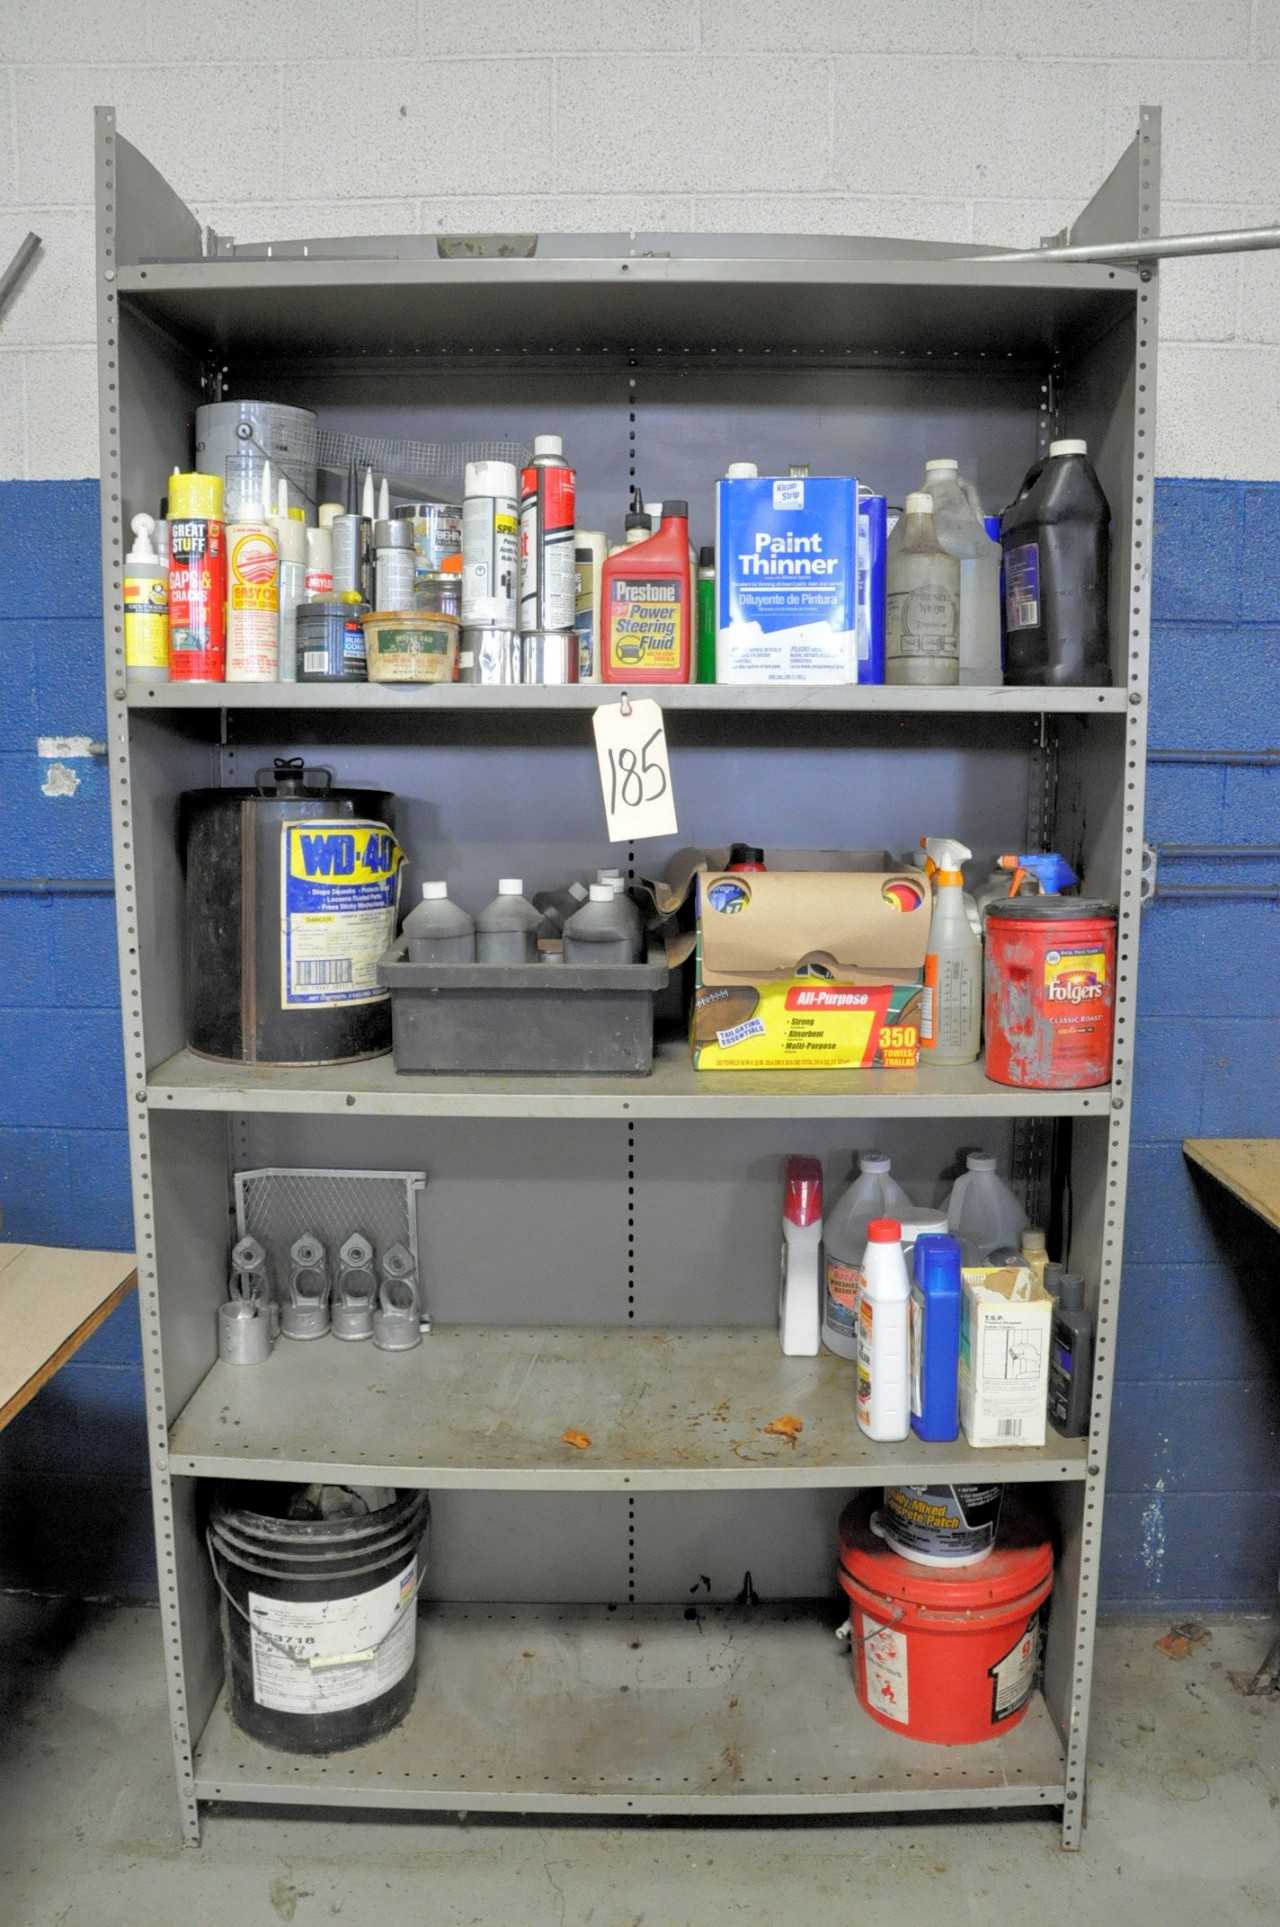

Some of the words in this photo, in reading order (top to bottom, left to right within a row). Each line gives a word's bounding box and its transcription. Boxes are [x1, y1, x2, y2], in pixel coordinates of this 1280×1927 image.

[172, 523, 206, 538] GREAT
[437, 530, 460, 541] BEHR
[172, 537, 206, 553] STUFF
[755, 532, 822, 553] Paint
[738, 553, 839, 575] Thinner
[170, 570, 199, 589] GAPS
[201, 570, 212, 589] &
[616, 581, 675, 601] Prestone
[787, 594, 800, 605] de
[802, 594, 838, 605] Pintura
[630, 604, 675, 619] Power
[616, 618, 676, 636] Steering
[639, 635, 674, 650] Fluid
[608, 728, 667, 815] 185
[301, 835, 392, 876] WD-40
[796, 991, 869, 1007] All-Purpose
[1048, 979, 1103, 1005] Folgers
[791, 1017, 815, 1027] Strong
[879, 1027, 917, 1047] 350
[785, 1041, 837, 1051] Multi-Purpose
[927, 1514, 961, 1529] Patch
